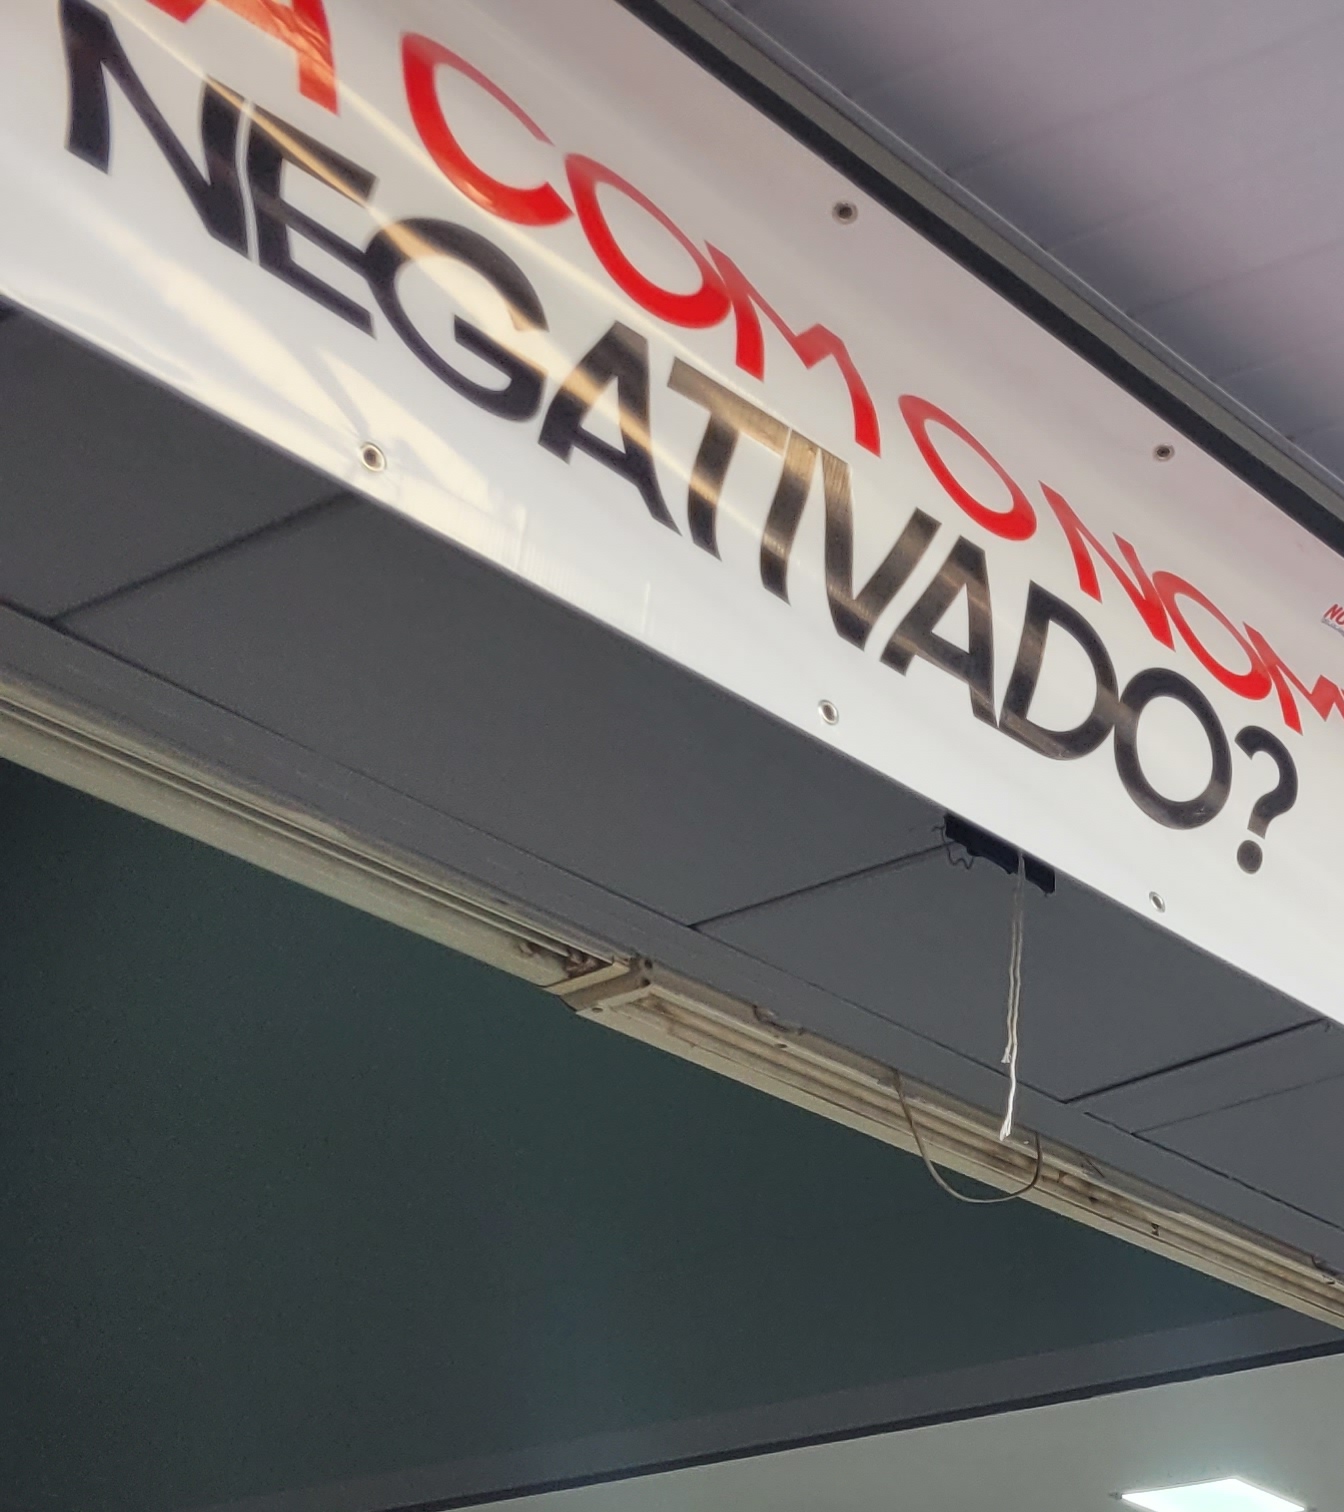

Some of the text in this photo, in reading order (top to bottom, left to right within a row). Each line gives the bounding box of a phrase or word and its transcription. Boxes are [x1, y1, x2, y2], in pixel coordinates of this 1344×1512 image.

[58, 0, 1299, 874] NEGATIVADO?
[401, 31, 882, 458] COM
[898, 394, 1037, 541] O
